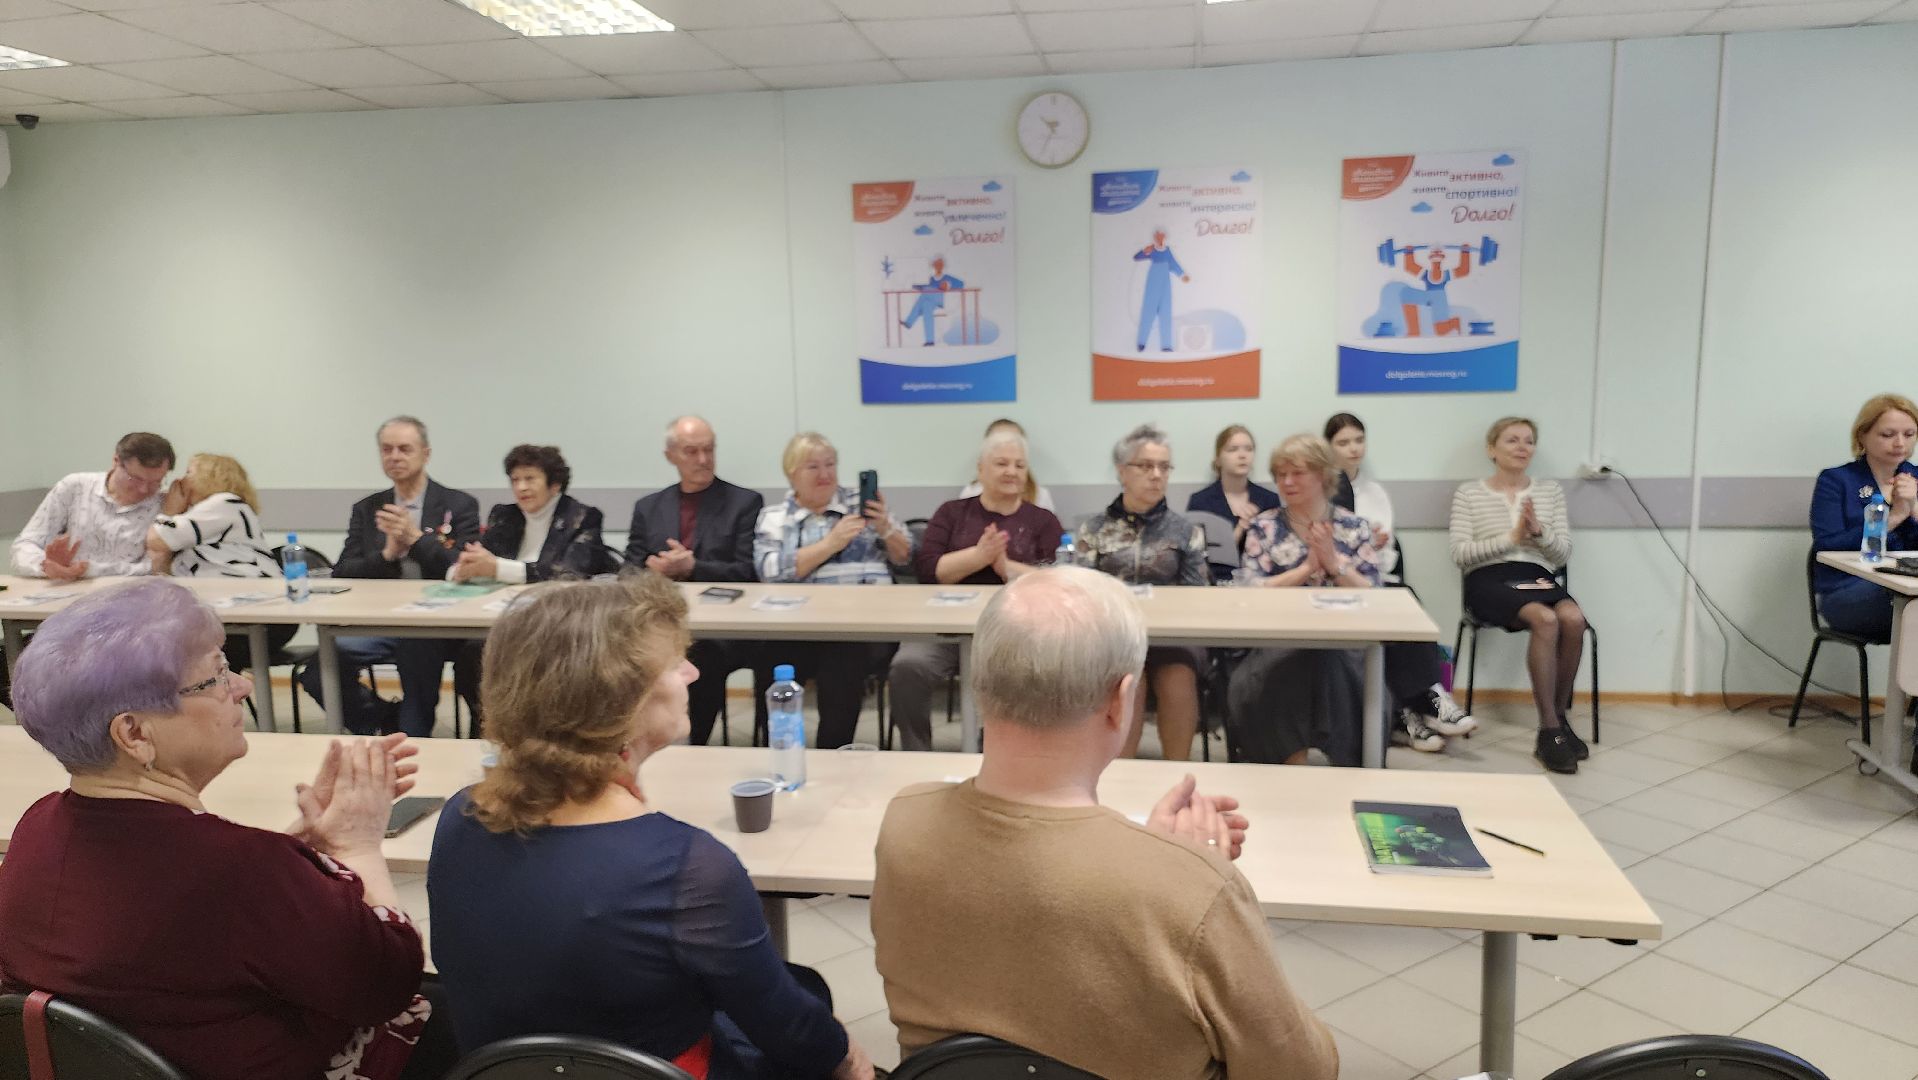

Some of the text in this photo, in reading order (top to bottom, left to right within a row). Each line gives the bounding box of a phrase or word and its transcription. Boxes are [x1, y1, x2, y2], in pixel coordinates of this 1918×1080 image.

[1445, 186, 1519, 200] спортивно!
[1451, 203, 1516, 224] Долго!
[950, 226, 1006, 246] Долго!
[1194, 217, 1255, 237] Долго!
